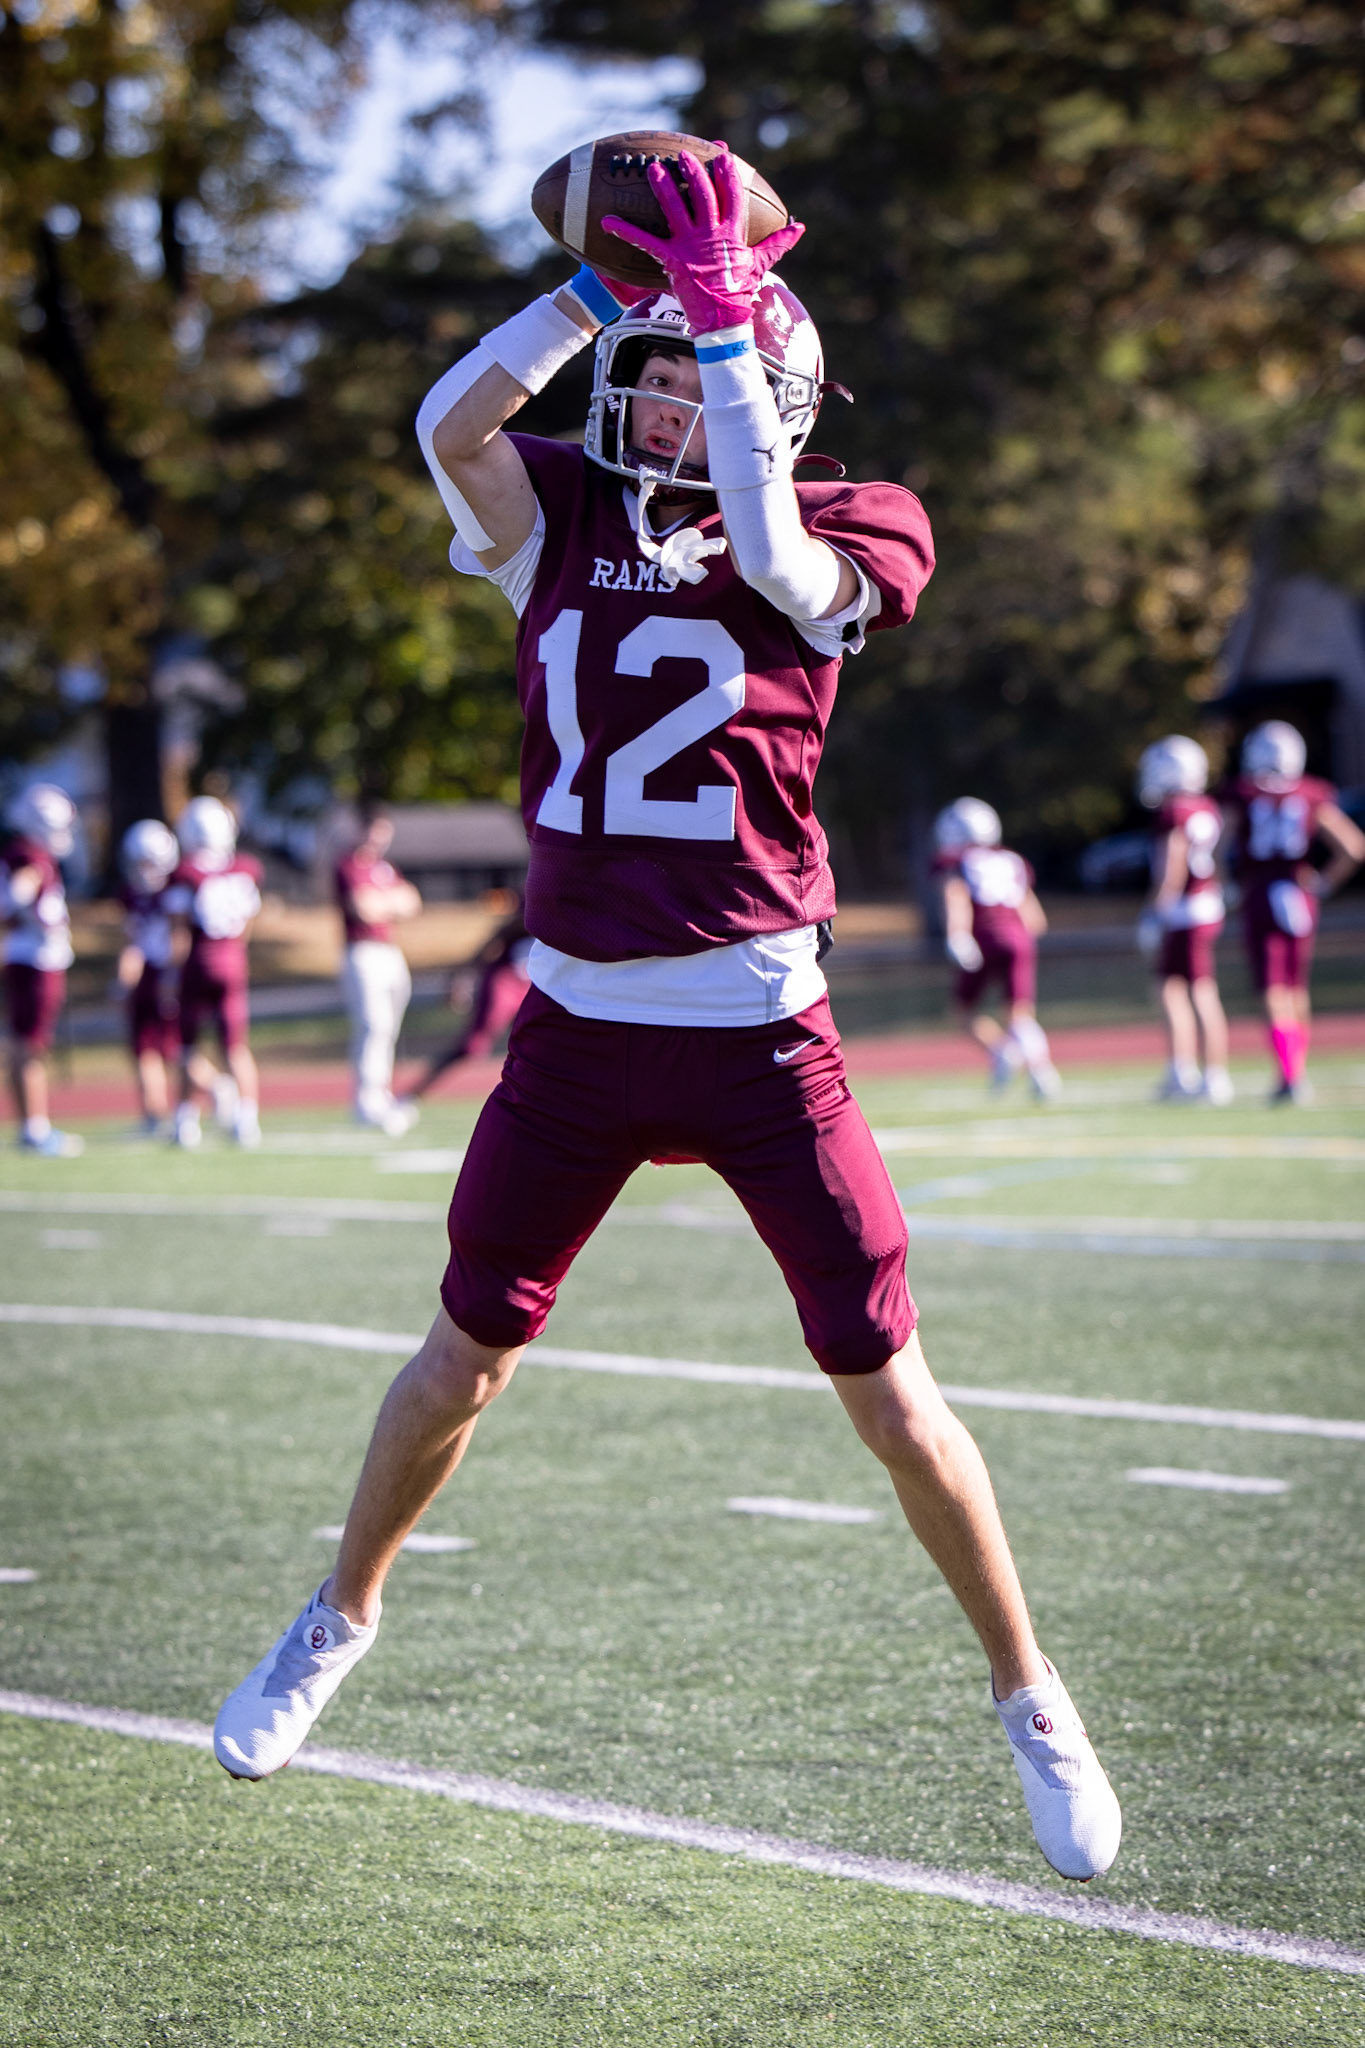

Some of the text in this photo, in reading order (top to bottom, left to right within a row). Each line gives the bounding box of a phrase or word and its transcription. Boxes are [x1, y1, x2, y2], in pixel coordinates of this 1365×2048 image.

[536, 608, 745, 841] 12
[311, 1625, 328, 1649] OU
[1032, 1713, 1053, 1735] OU
